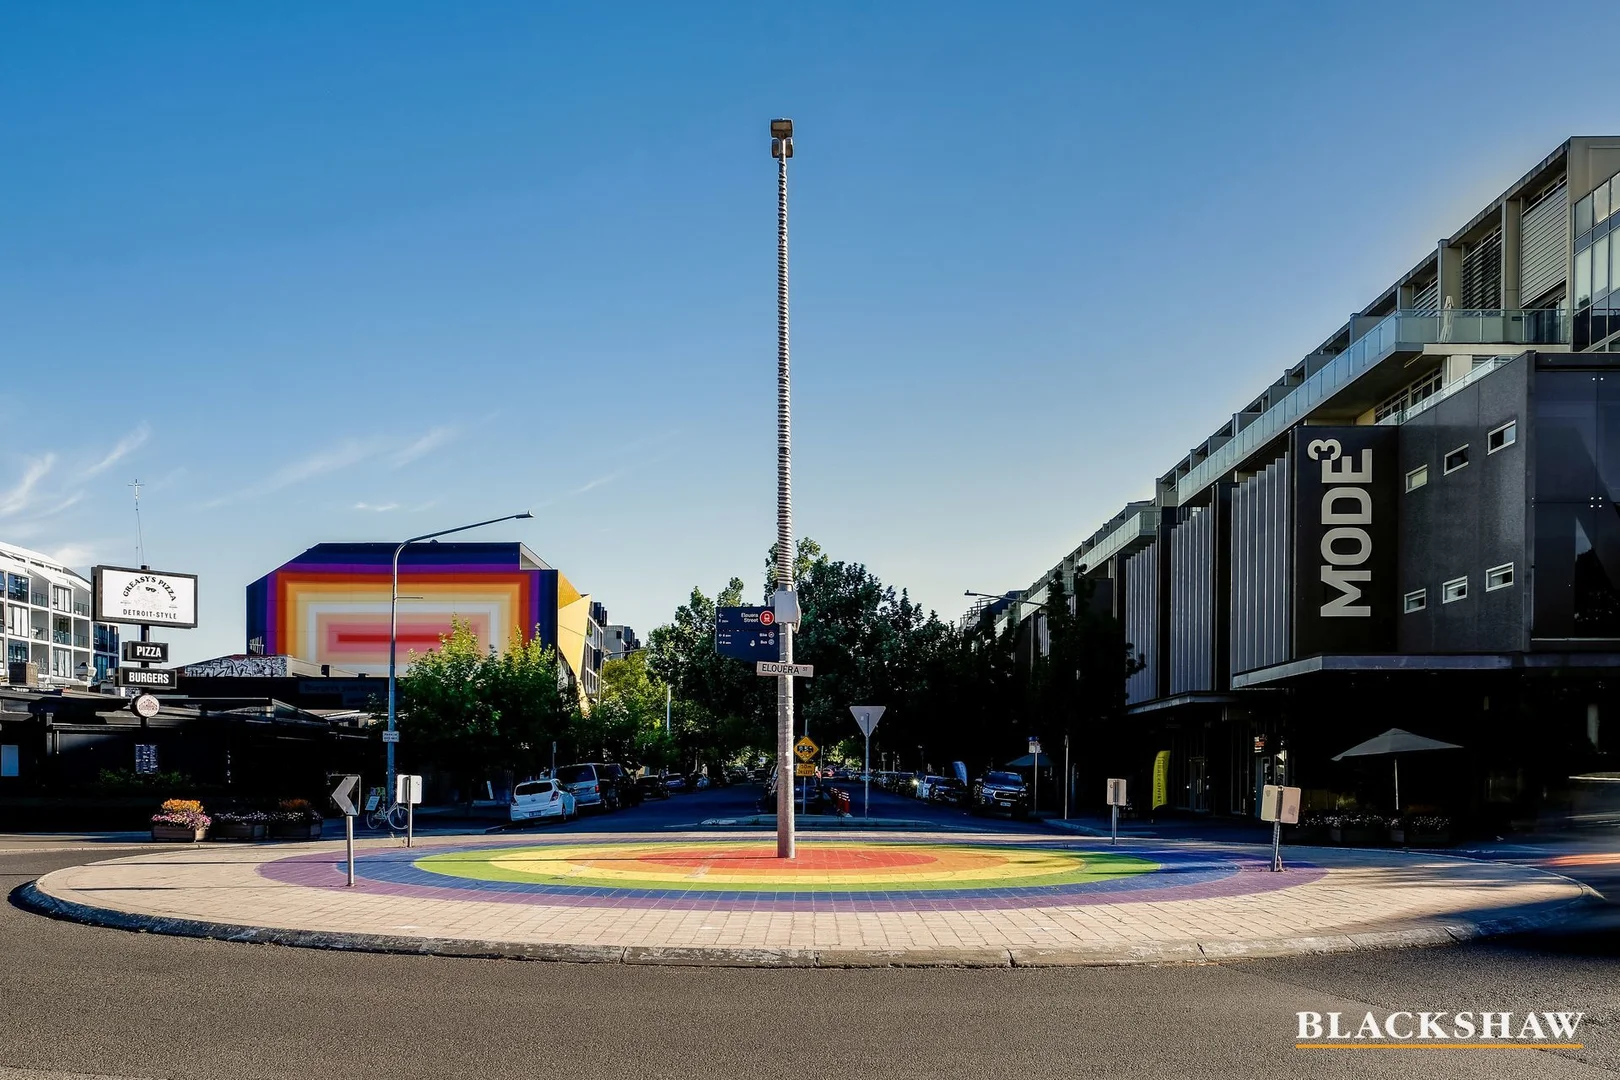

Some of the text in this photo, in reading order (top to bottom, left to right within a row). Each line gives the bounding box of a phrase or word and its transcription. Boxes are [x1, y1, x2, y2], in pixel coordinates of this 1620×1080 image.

[123, 576, 177, 602] GREASY'S PIZZA
[123, 608, 177, 620] DETROIT-STYLE
[136, 645, 162, 658] PIZZA
[761, 663, 800, 675] ELOUERA
[128, 671, 169, 684] BURGERS
